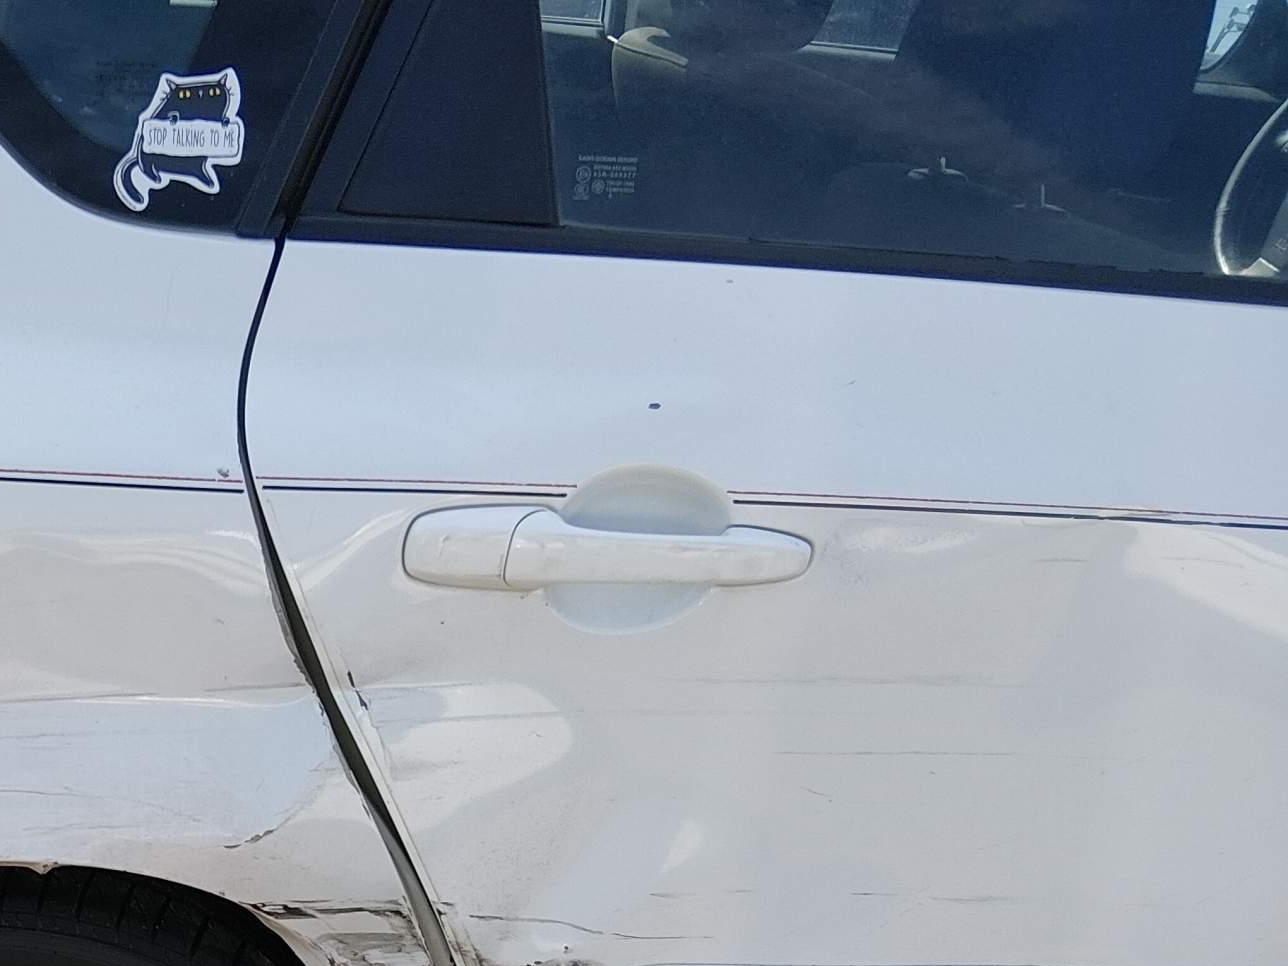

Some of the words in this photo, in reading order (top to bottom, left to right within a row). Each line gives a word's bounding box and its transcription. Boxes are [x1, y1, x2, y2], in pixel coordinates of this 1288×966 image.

[148, 127, 168, 147] STOP
[172, 127, 205, 148] TALKING
[210, 128, 220, 148] TO
[223, 128, 235, 148] ME
